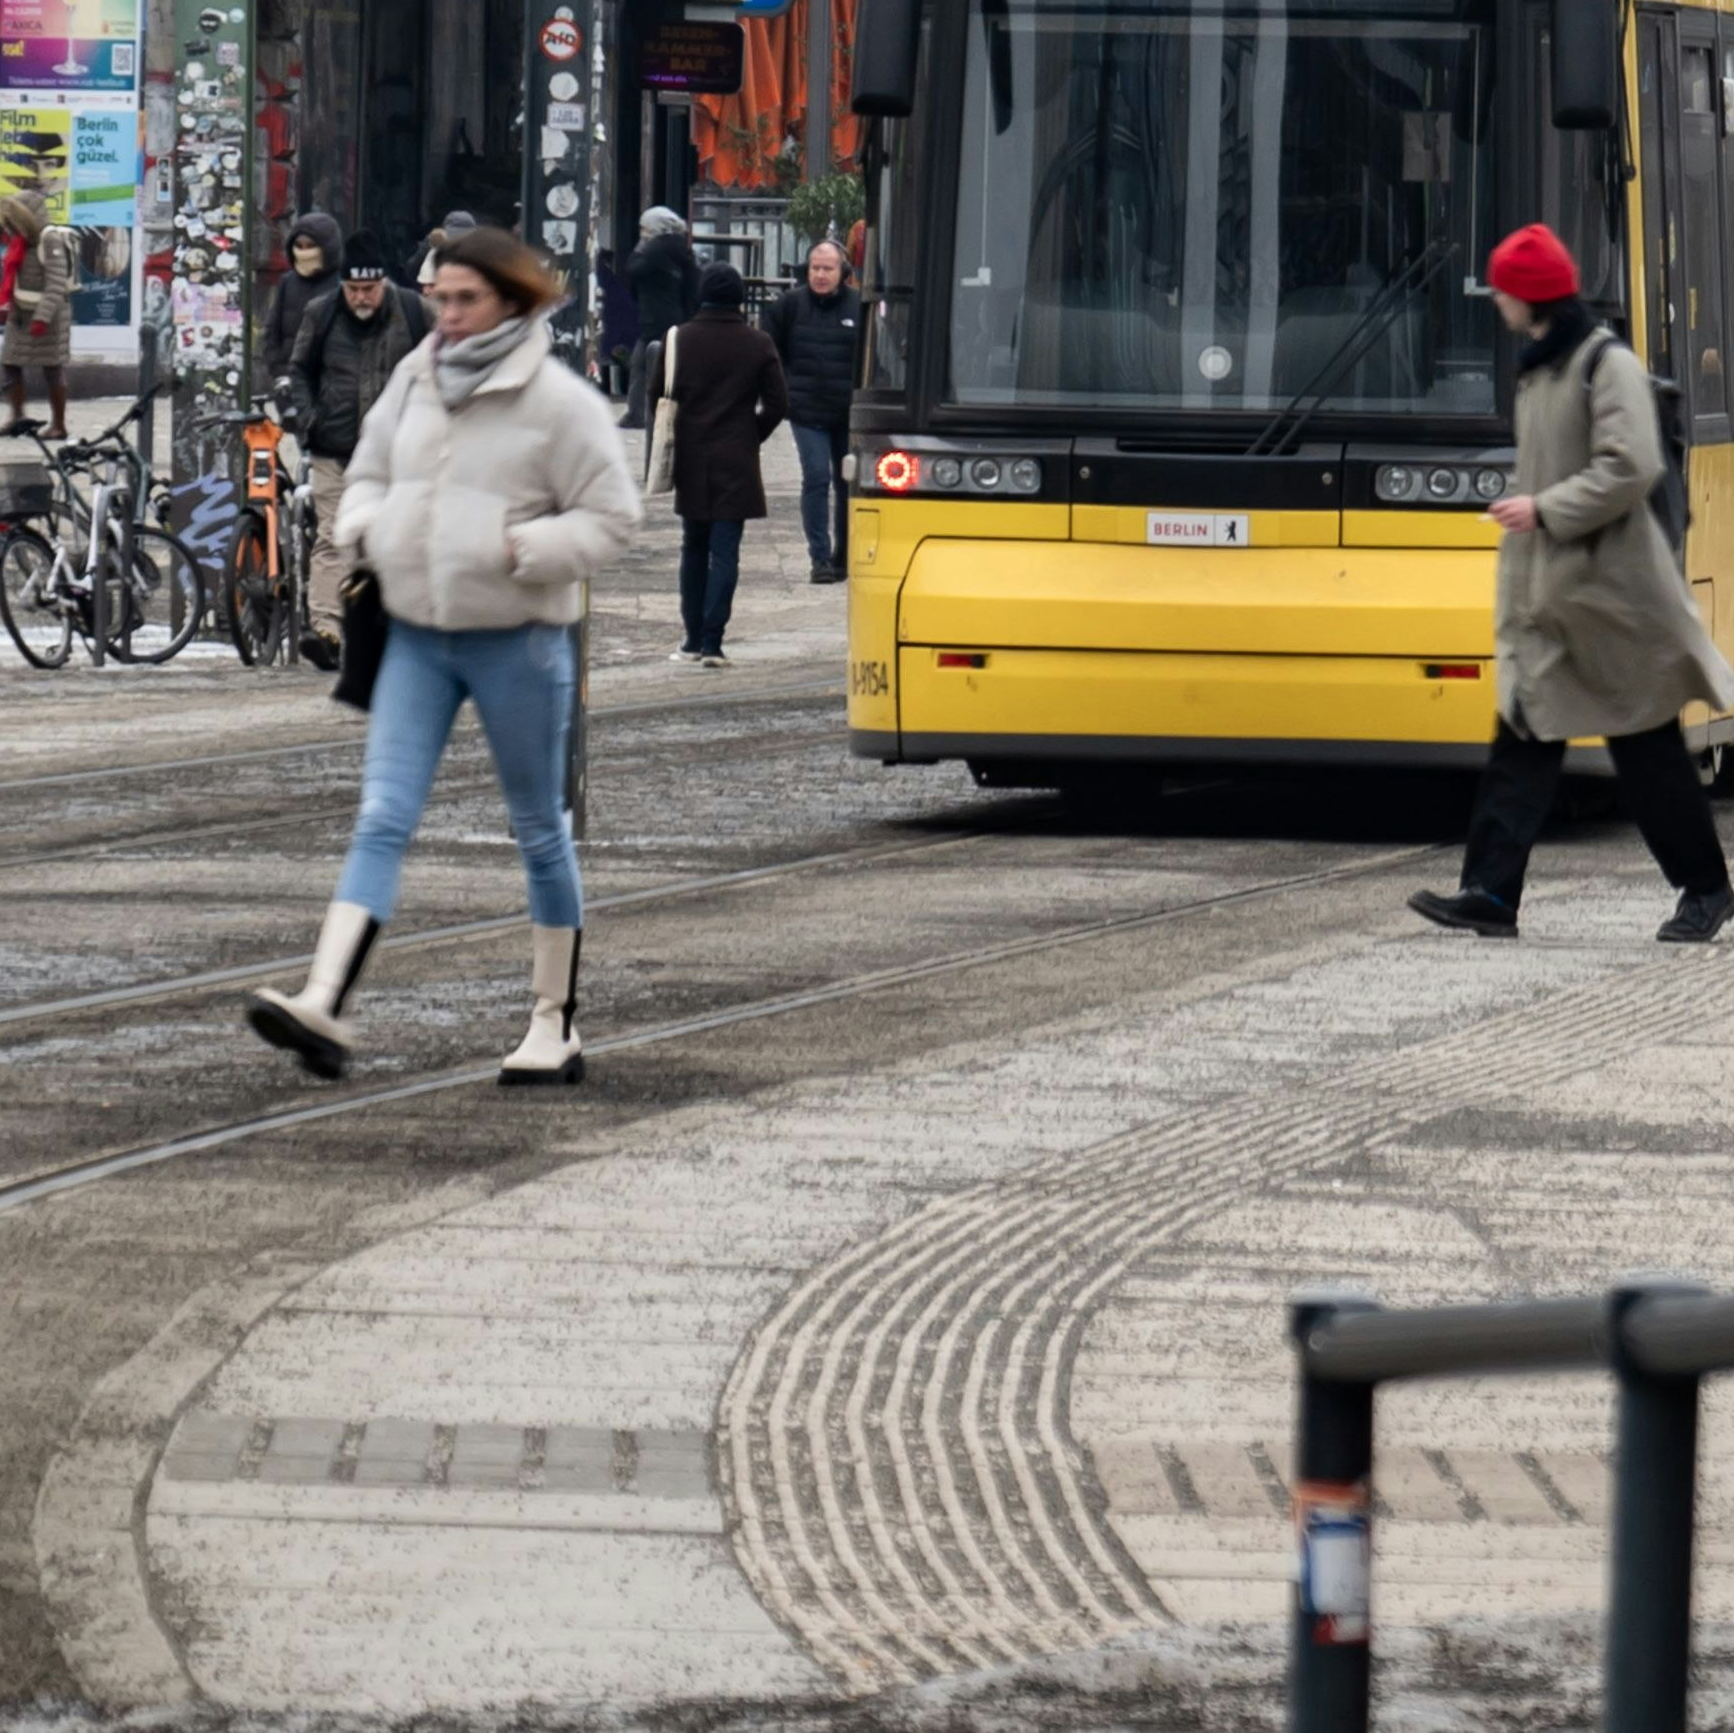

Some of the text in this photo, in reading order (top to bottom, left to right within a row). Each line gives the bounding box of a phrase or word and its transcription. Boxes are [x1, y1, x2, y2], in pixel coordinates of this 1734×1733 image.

[0, 111, 37, 126] Film
[77, 117, 118, 131] Berlin
[76, 134, 104, 149] çok
[1153, 522, 1209, 537] BERLIN
